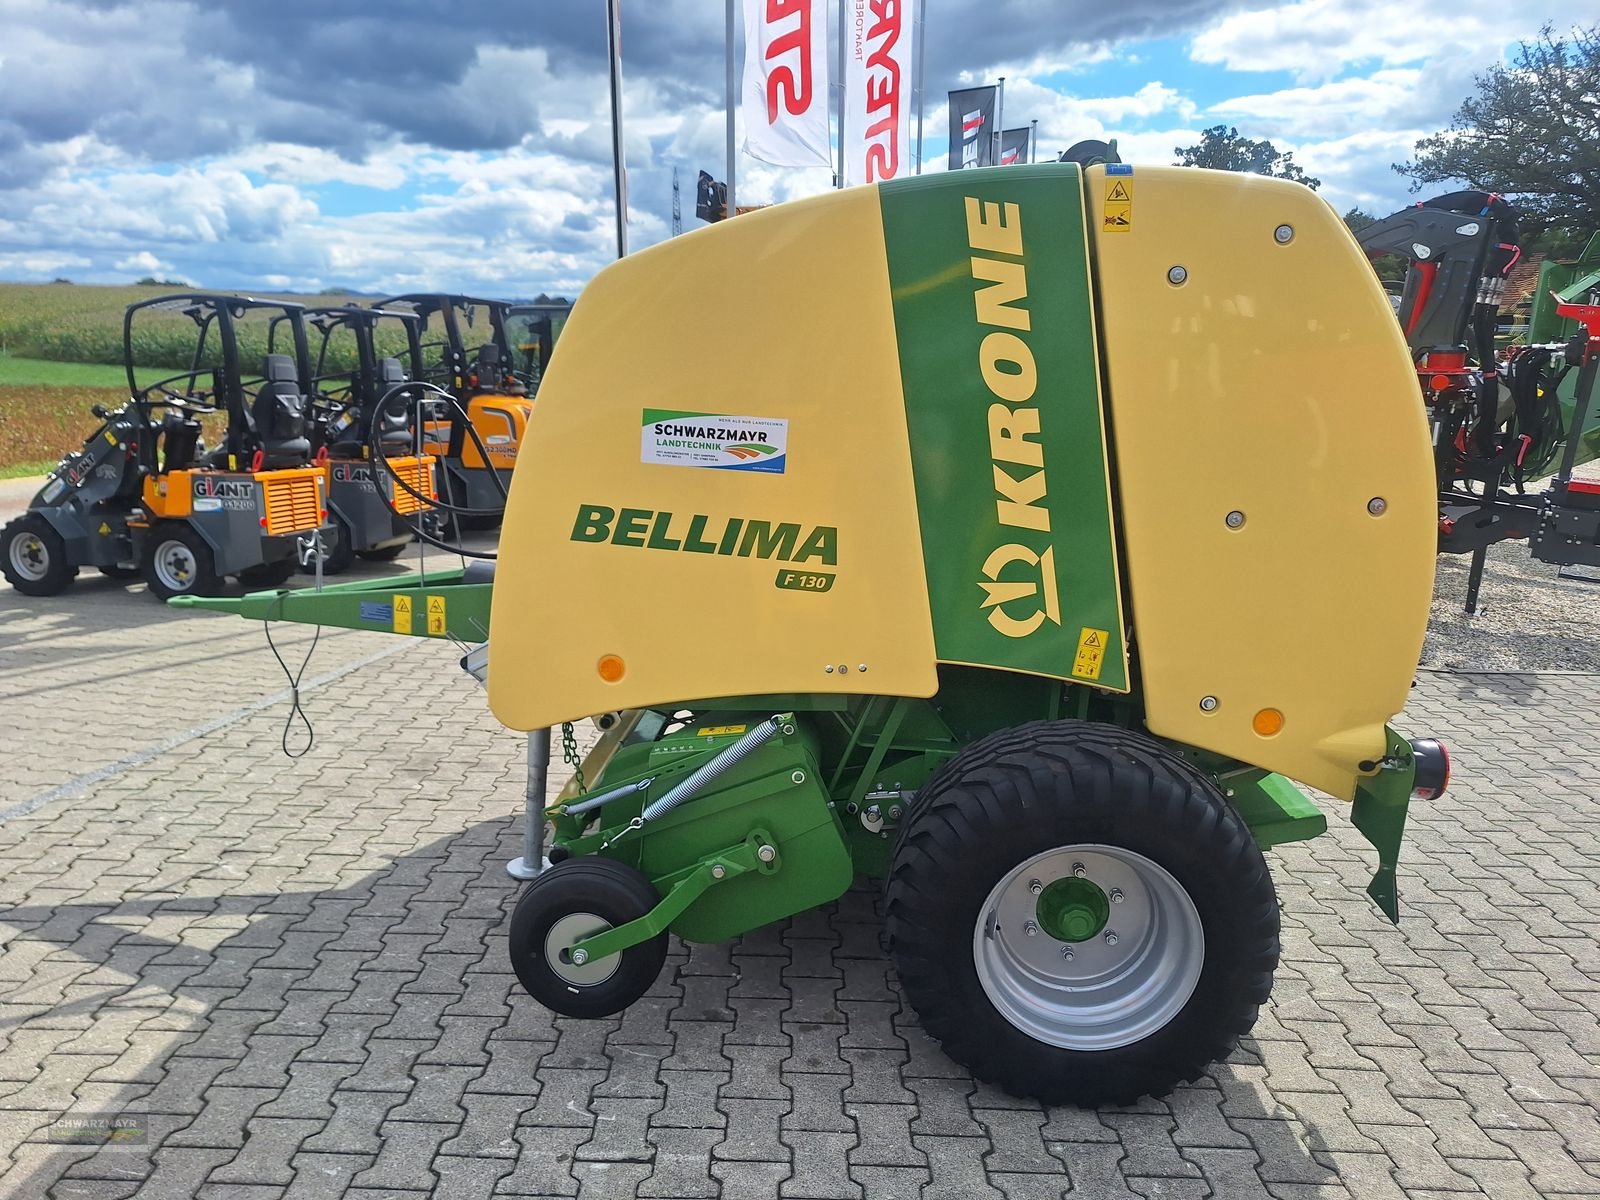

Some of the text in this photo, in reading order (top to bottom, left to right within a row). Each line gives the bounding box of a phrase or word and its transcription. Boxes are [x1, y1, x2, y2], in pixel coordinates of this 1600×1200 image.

[964, 197, 1051, 532] KRONE
[654, 423, 768, 443] SCHWARZMAYR
[656, 439, 722, 451] LANDTECHNIK
[569, 503, 838, 566] BELLIMA
[783, 573, 827, 589] F 130
